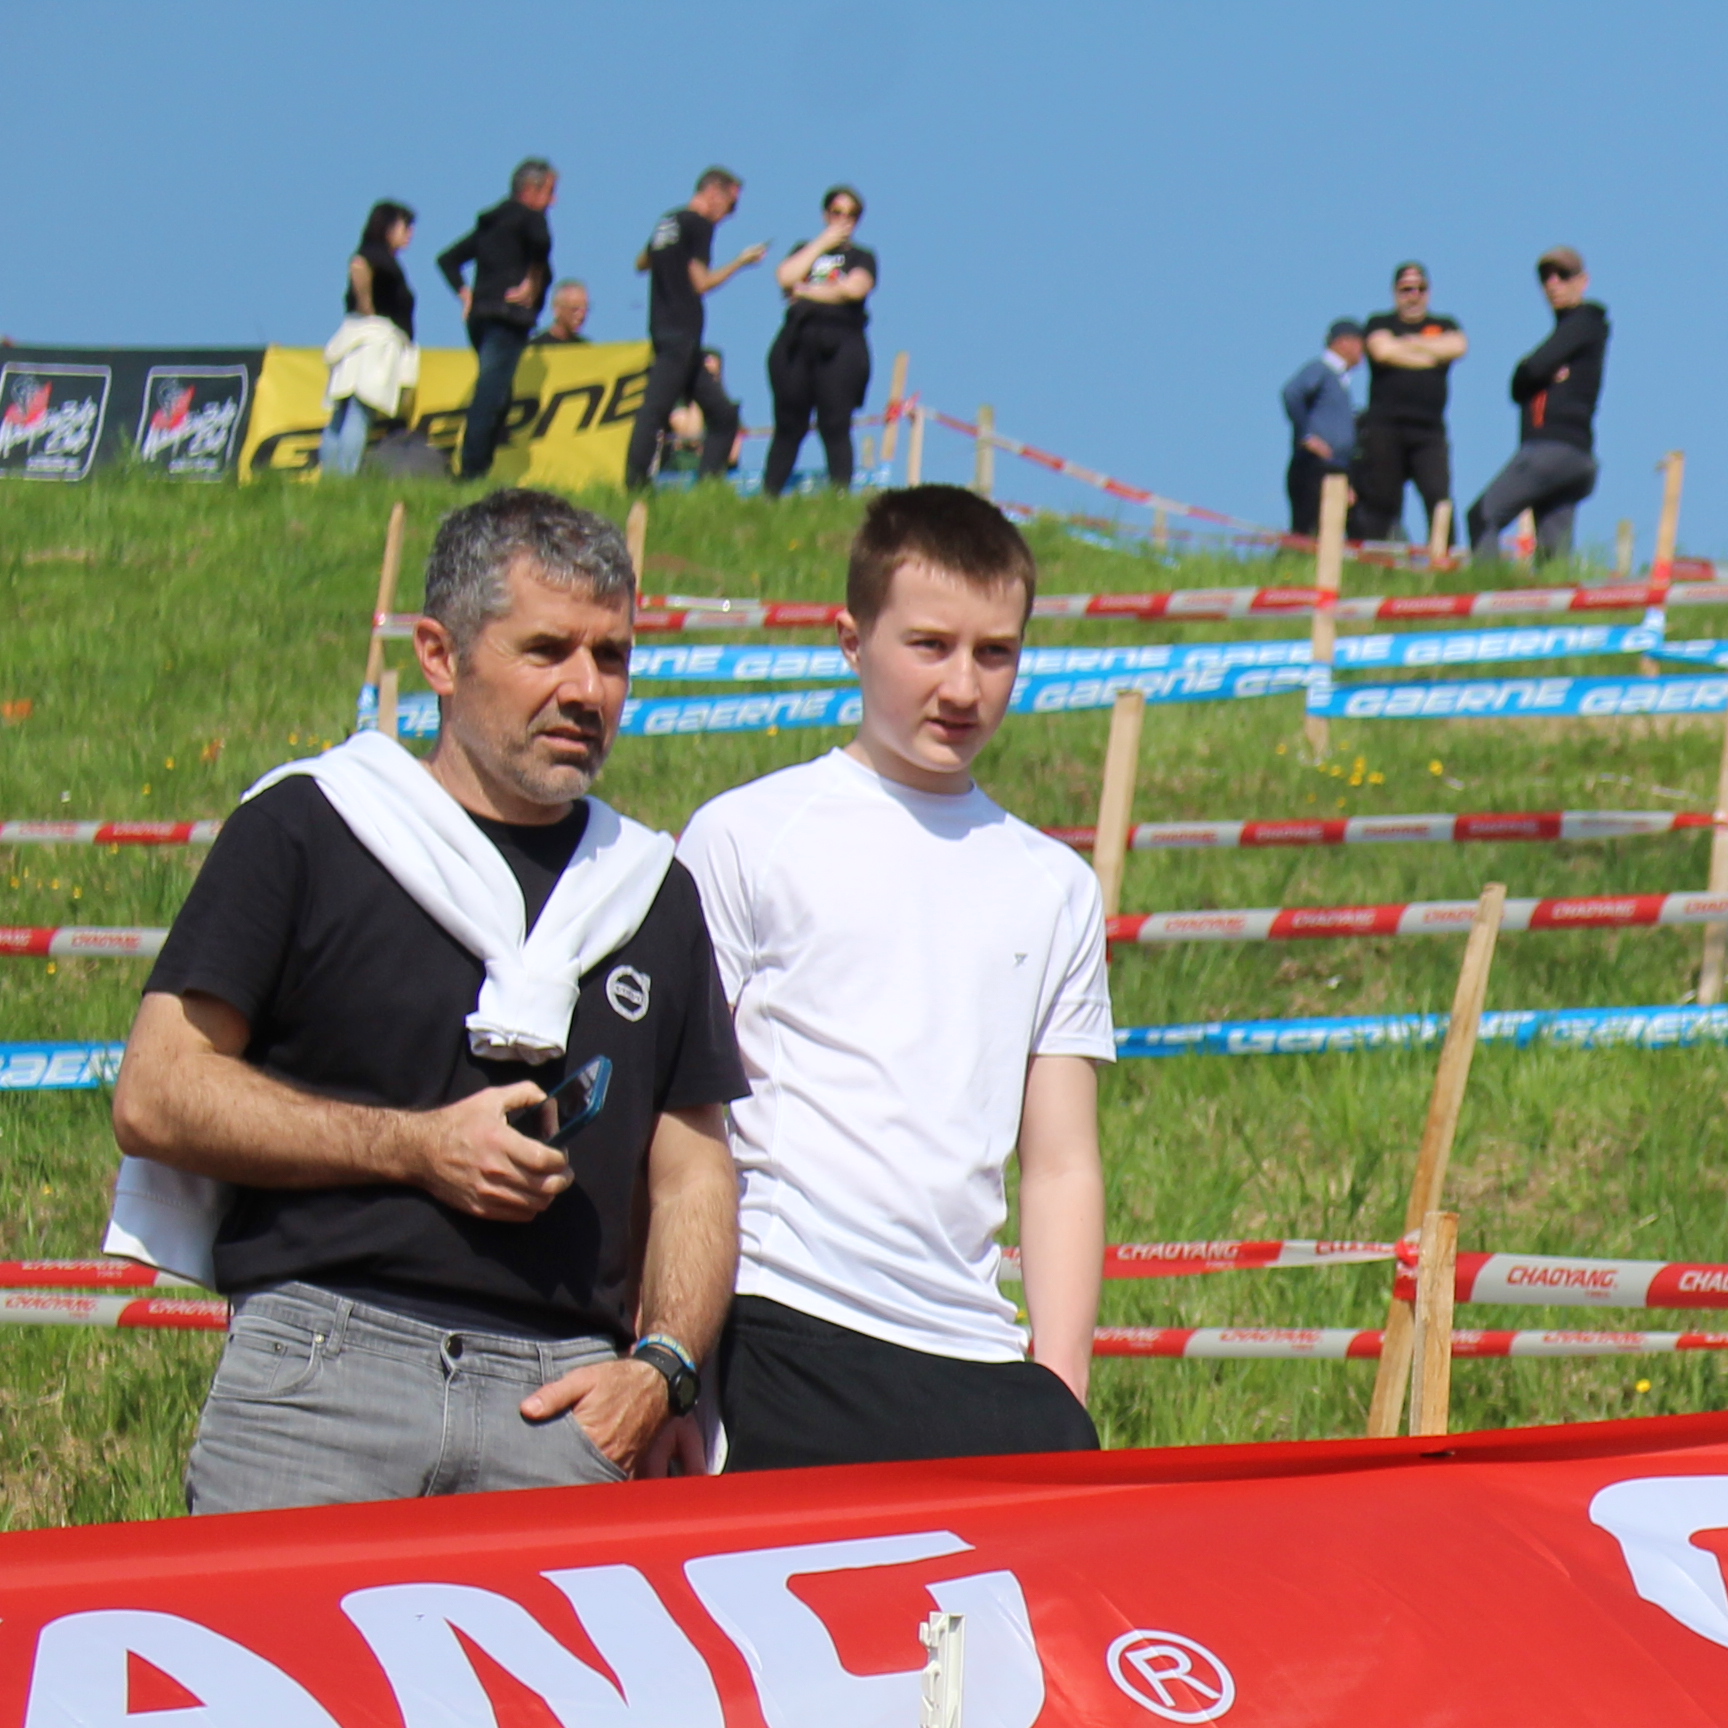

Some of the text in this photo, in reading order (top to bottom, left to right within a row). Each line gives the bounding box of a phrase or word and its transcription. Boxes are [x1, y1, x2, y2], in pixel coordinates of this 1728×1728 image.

[645, 687, 829, 734] GAERNE
[1346, 678, 1575, 717] GAERNE
[1506, 1265, 1613, 1291] CHAOYANG
